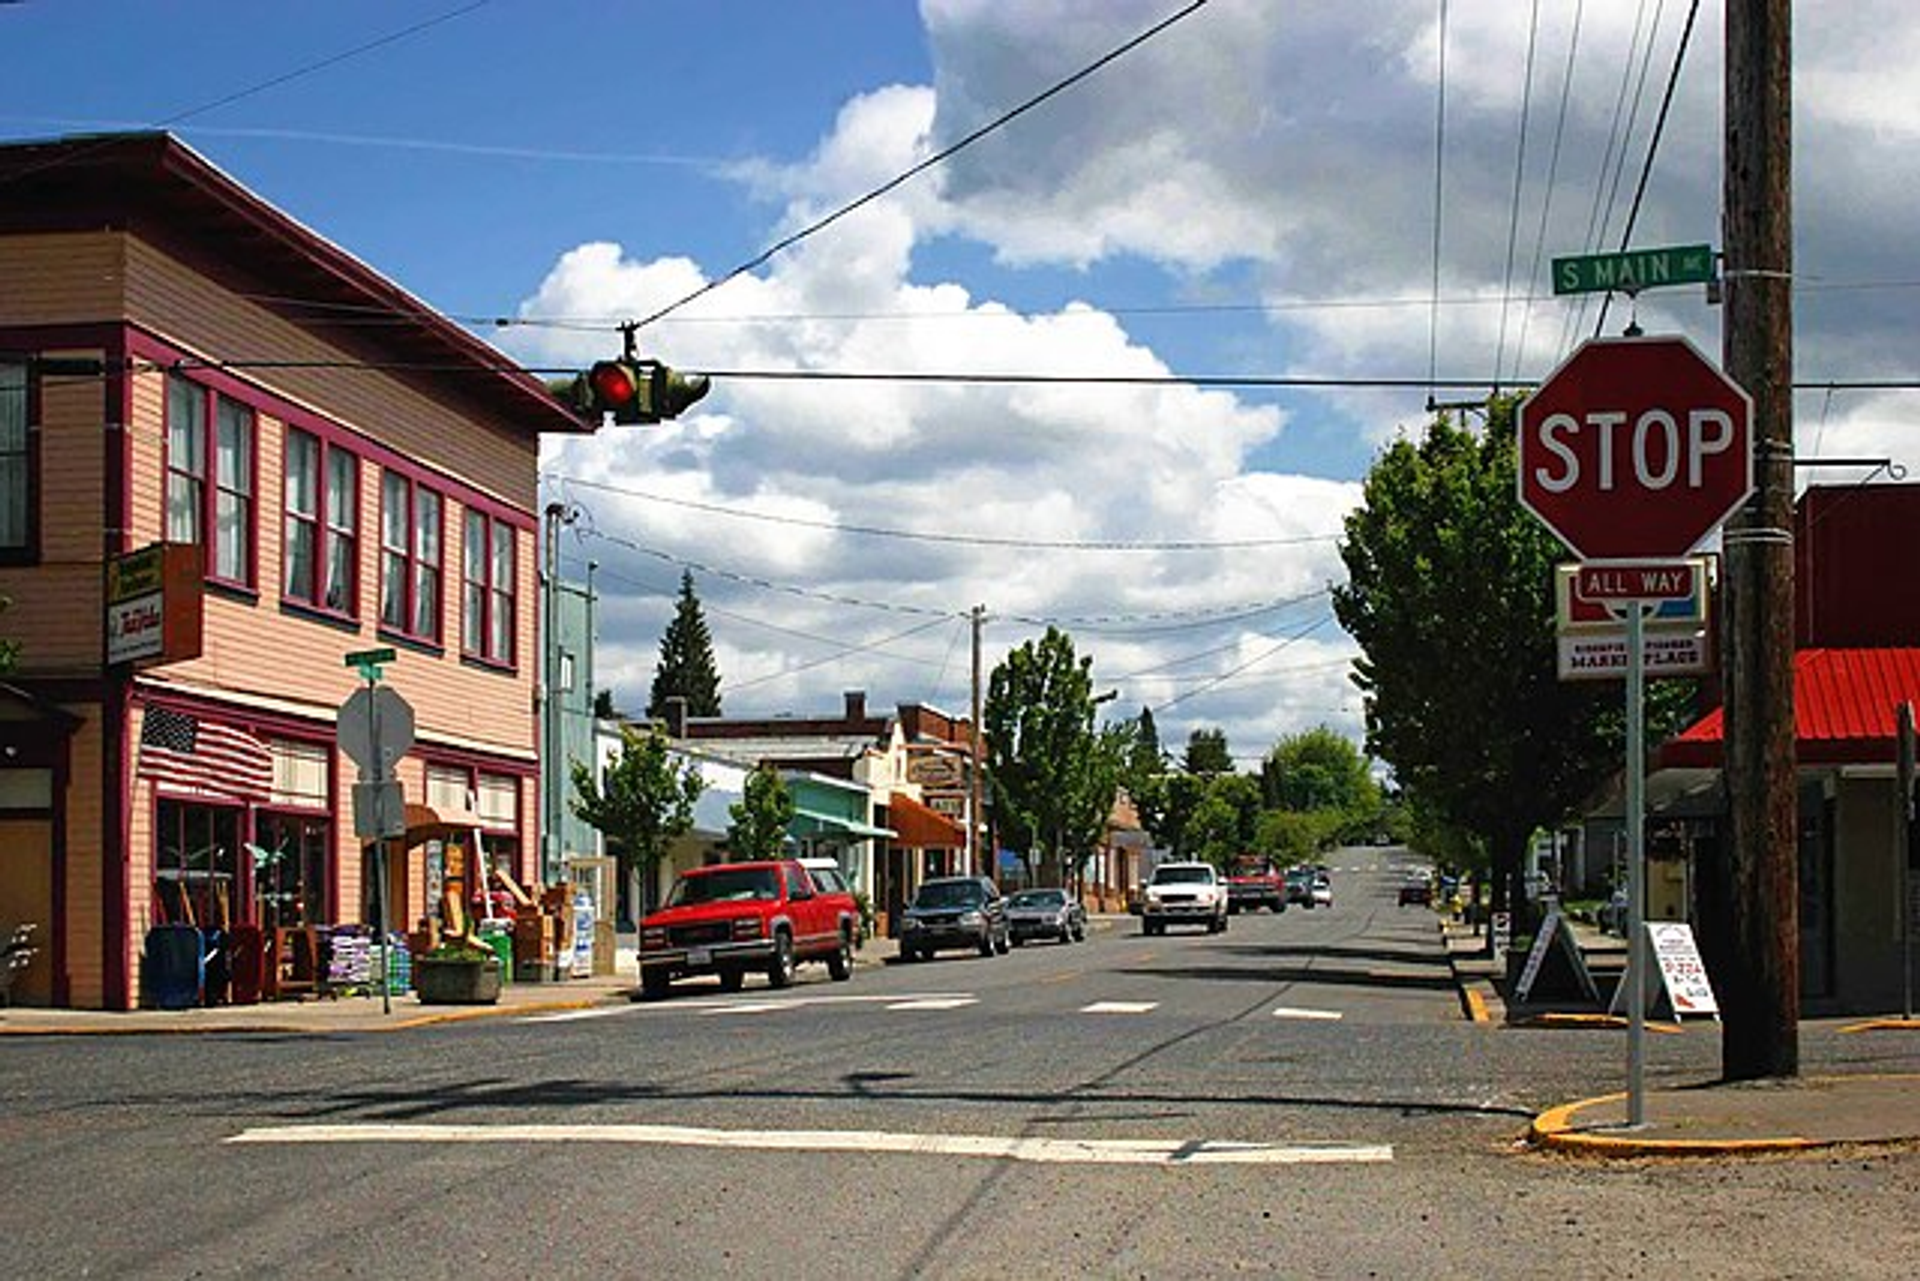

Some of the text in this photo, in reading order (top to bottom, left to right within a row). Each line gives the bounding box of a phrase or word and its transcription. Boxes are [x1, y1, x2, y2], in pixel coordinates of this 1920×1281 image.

[1562, 261, 1580, 290] S
[1595, 252, 1670, 286] MAIN
[1535, 408, 1734, 493] STOP
[1586, 571, 1684, 593] ALL WAY
